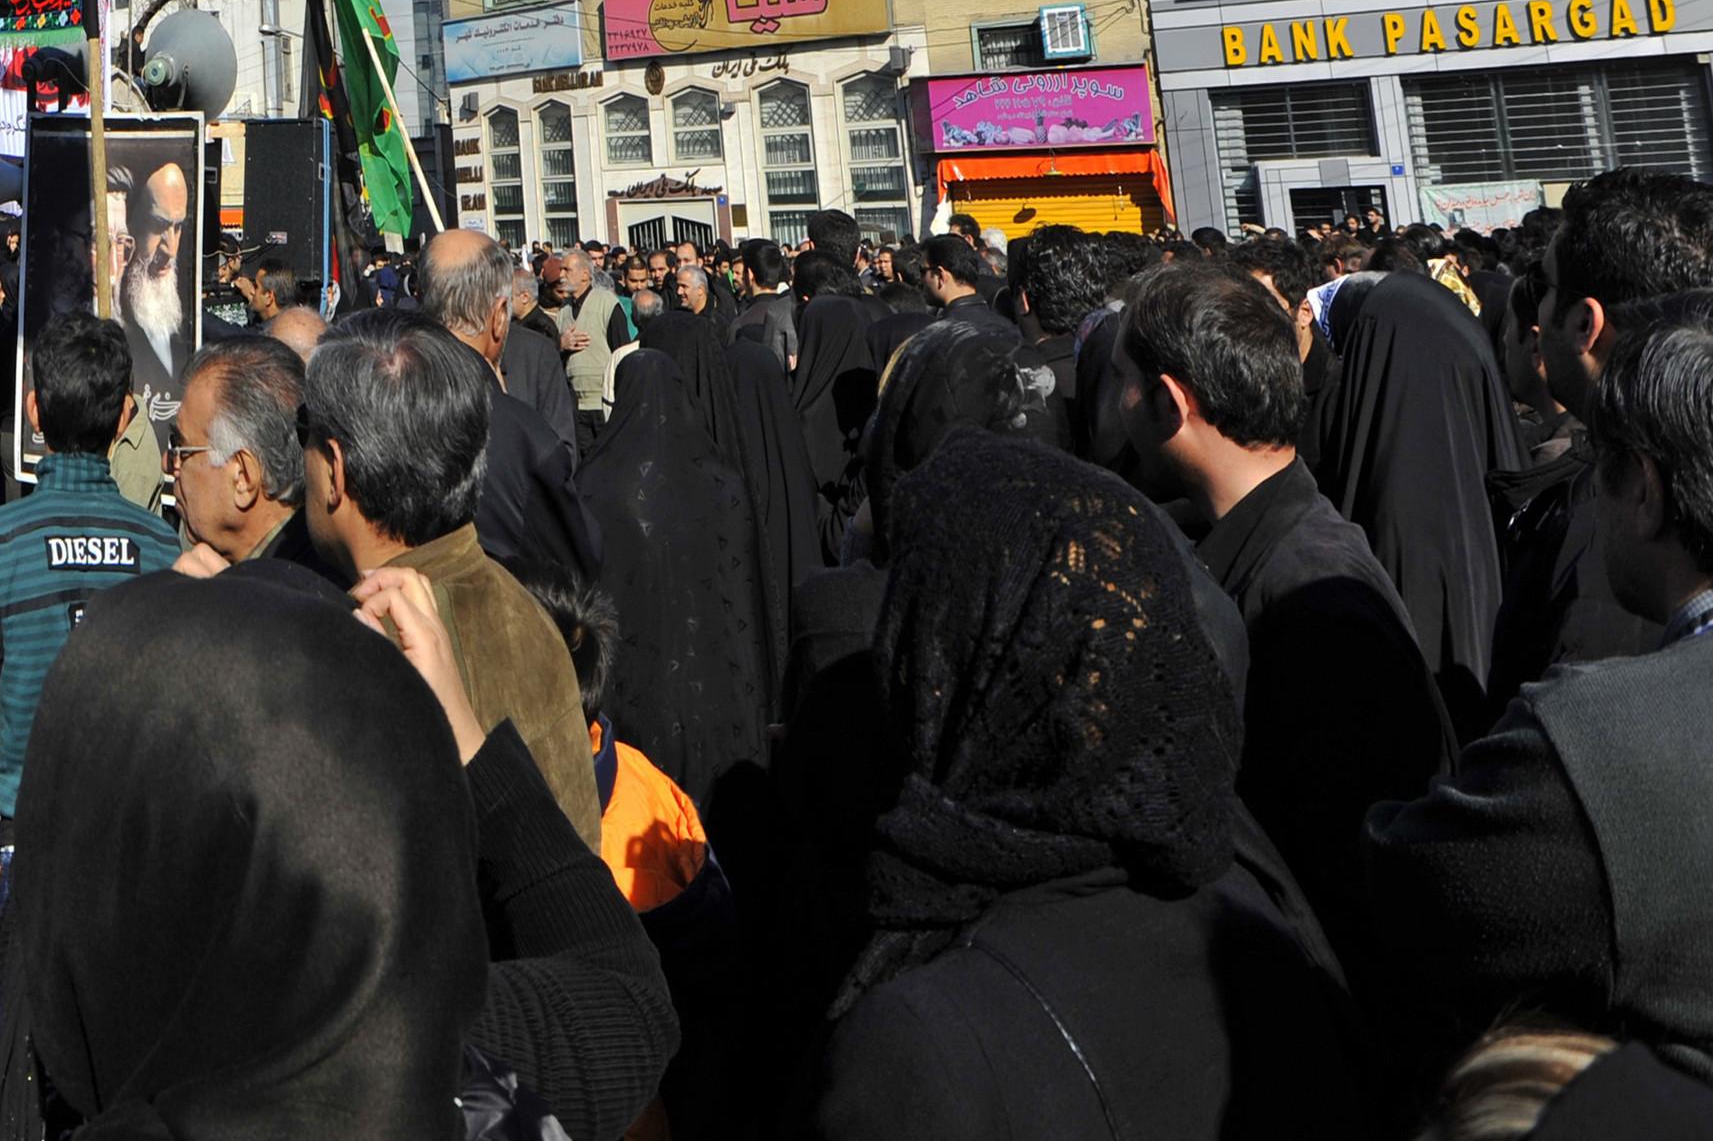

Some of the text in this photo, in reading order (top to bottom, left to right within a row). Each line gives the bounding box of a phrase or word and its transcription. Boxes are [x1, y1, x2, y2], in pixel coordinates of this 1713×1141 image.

[654, 1, 678, 12] خدمات
[514, 19, 541, 31] خدمات
[543, 13, 564, 29] دفتر
[474, 23, 512, 38] الکترونیک
[1223, 17, 1354, 66] BANK
[712, 58, 741, 79] ایران
[760, 52, 789, 74] بانک
[953, 71, 1125, 110] سوپر ارزونی شاهد
[454, 138, 481, 156] BANK
[626, 181, 655, 198] ایران
[668, 168, 701, 197] بانک
[461, 193, 487, 211] IRAN
[48, 538, 135, 566] DIESEL
